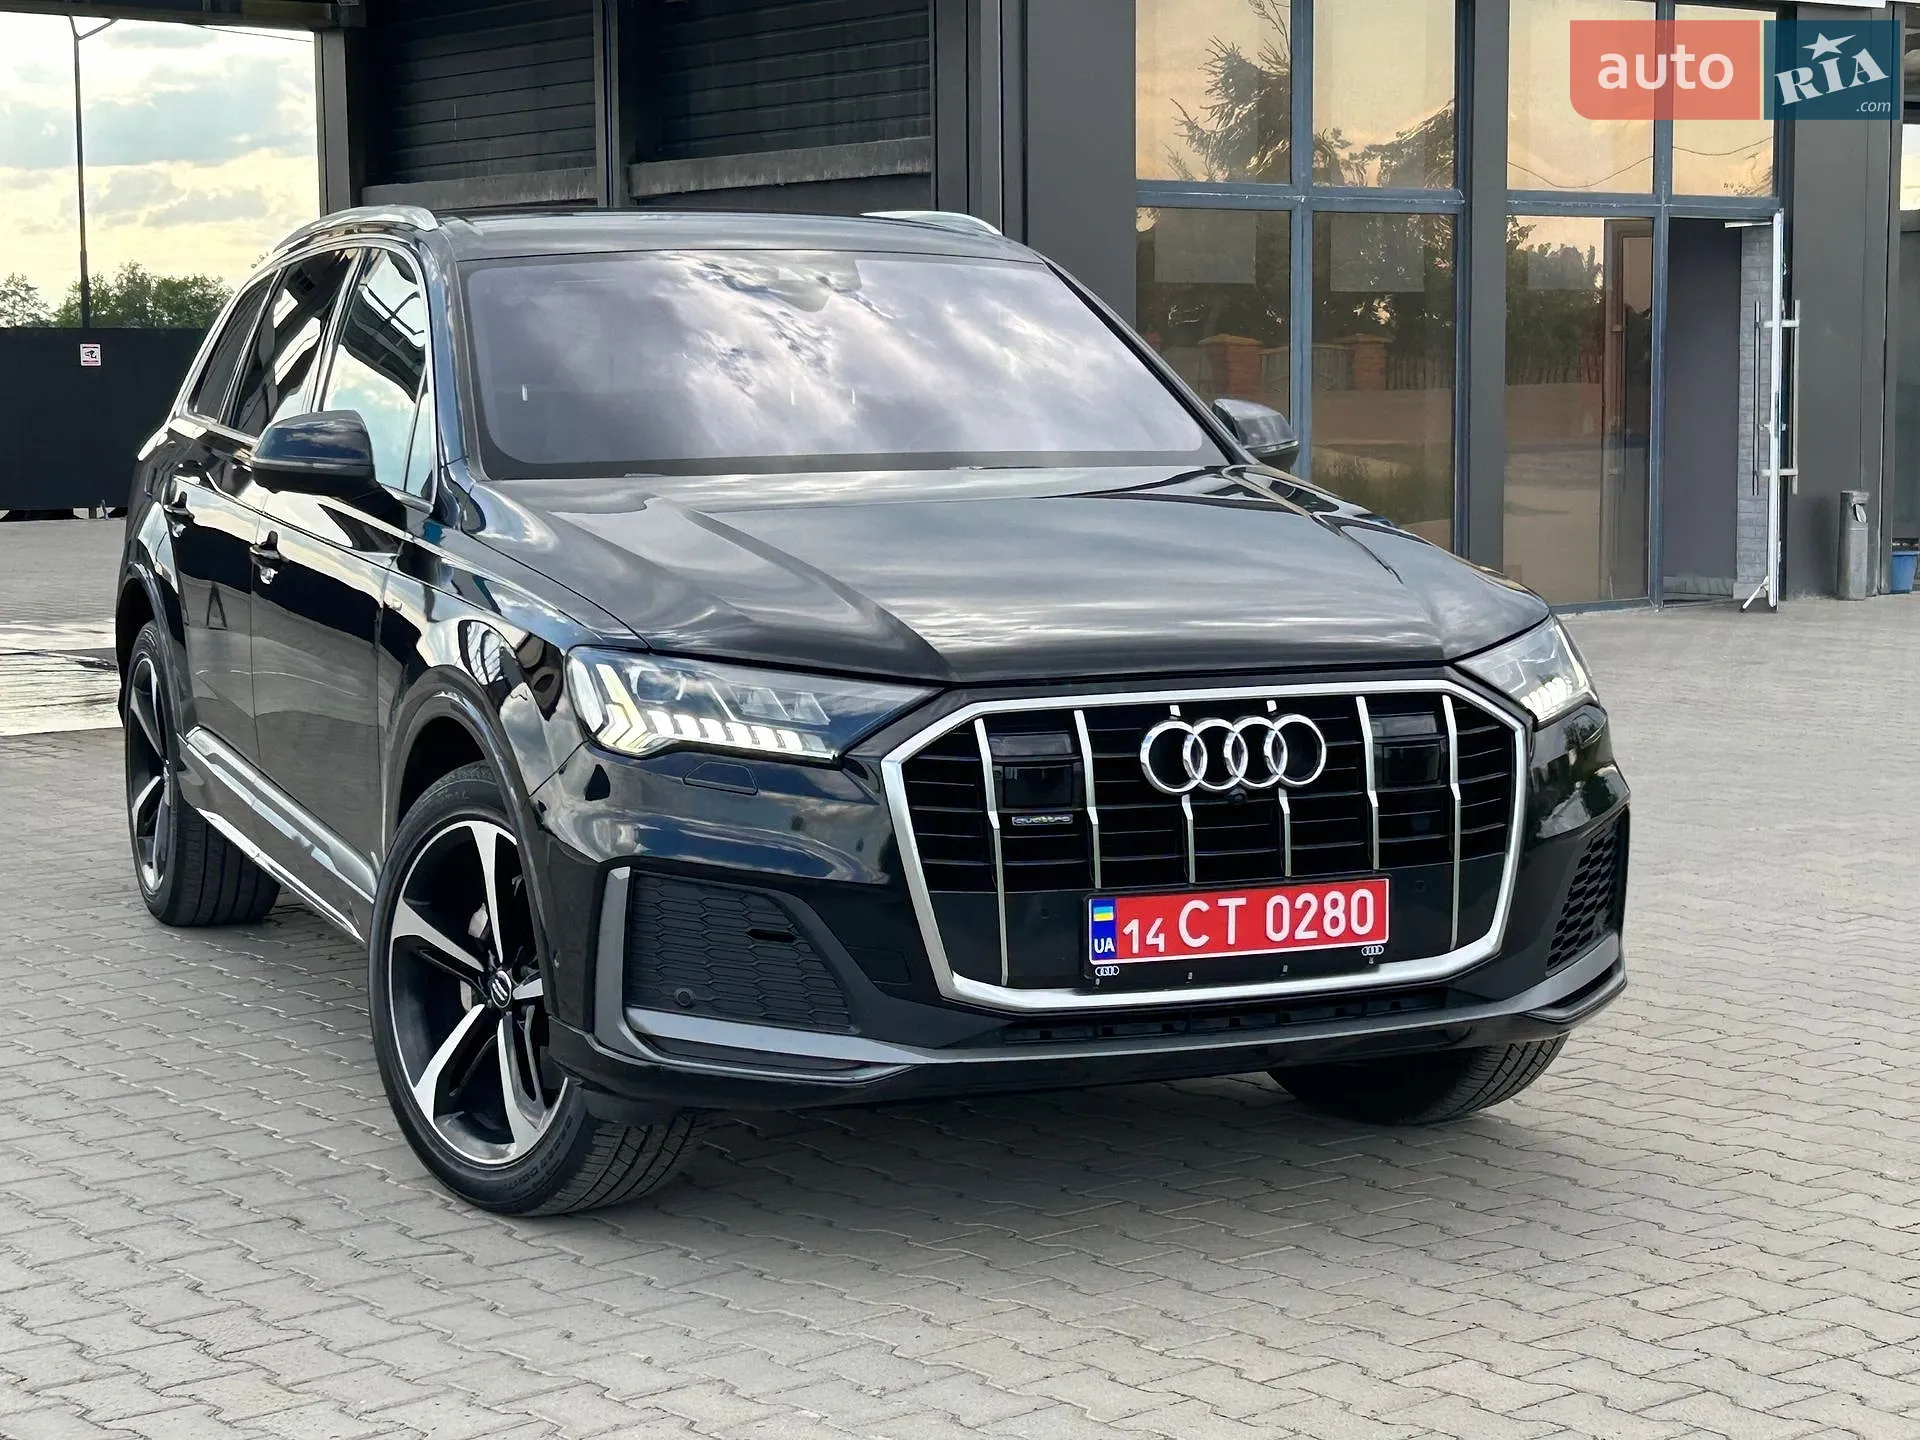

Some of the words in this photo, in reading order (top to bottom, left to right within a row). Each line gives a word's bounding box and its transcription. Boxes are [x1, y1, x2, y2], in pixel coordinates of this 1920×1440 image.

[1123, 917, 1165, 953] 14
[1178, 897, 1247, 948] CT
[1265, 888, 1374, 942] 0280
[1094, 938, 1115, 953] UA
